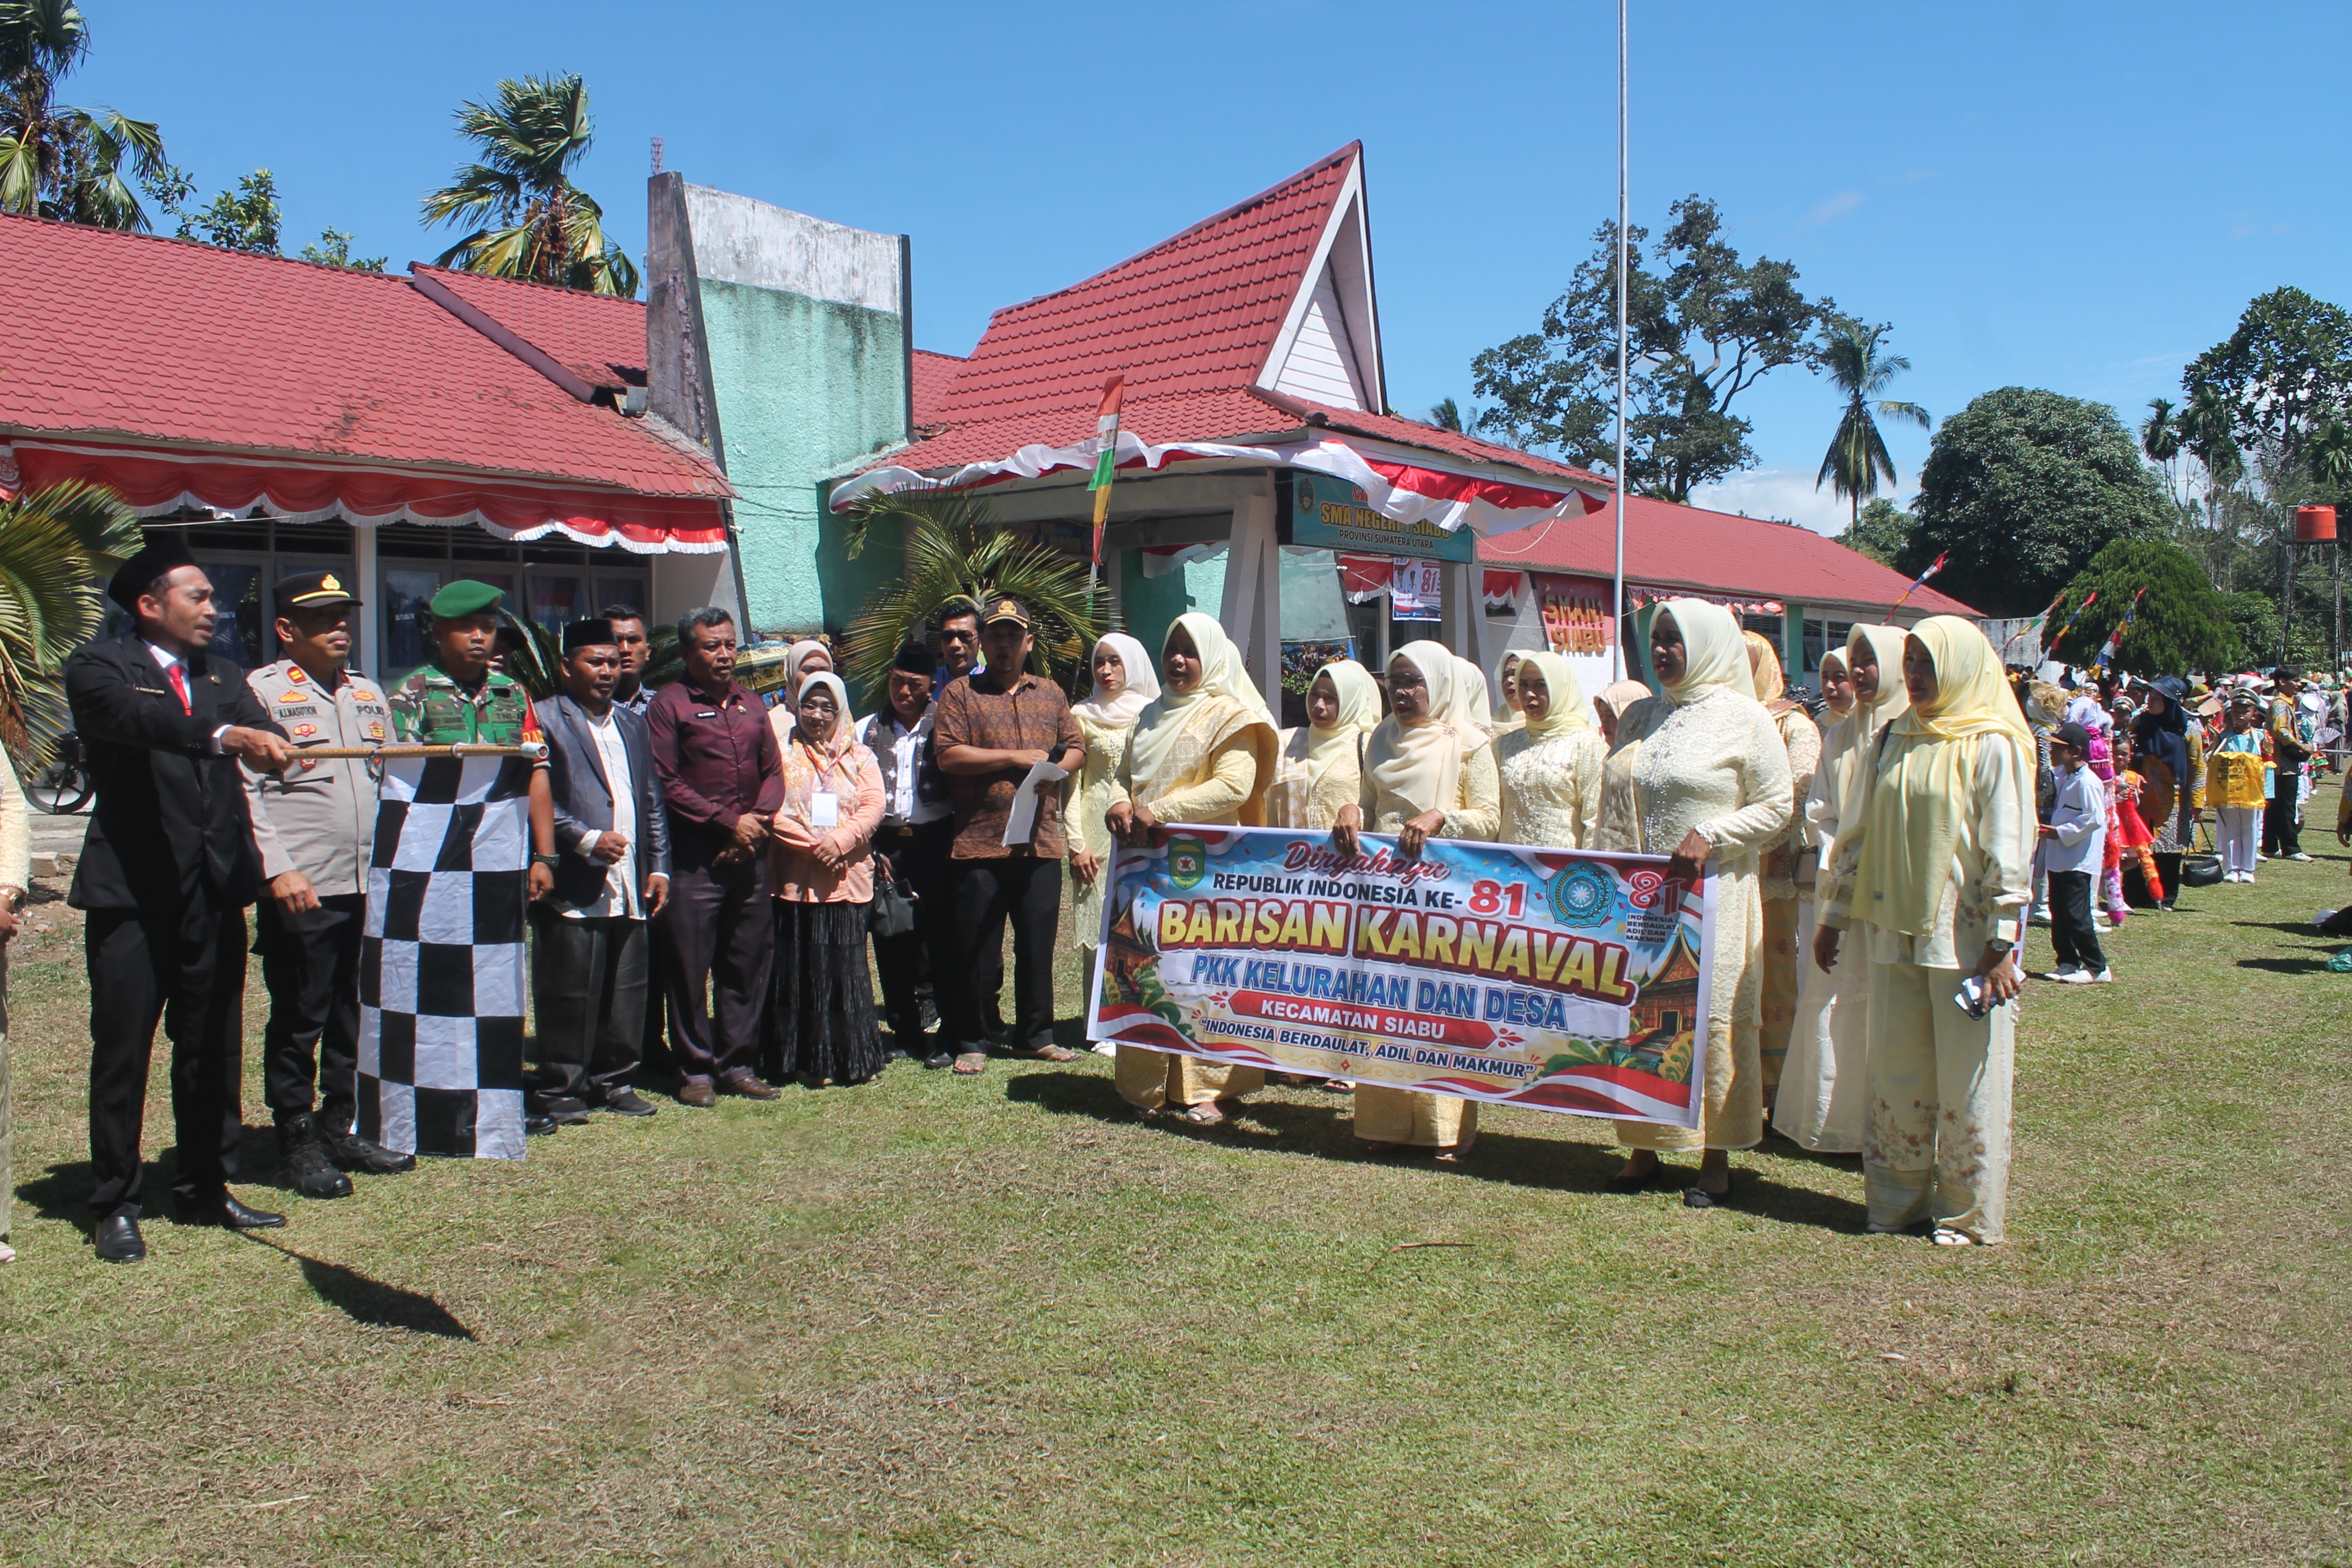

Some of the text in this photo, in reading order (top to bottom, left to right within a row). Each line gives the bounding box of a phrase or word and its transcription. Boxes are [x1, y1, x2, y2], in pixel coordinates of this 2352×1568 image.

[1353, 485, 1369, 502] Sela
[1321, 502, 1353, 527] SMA
[1339, 529, 1434, 549] PROVINSI SUMATERA UTARA
[1551, 627, 1606, 653] SIABU
[356, 705, 385, 716] POLRI
[1284, 841, 1449, 883] Dirgahayu
[1213, 873, 1527, 918] REPUBLIK INDONESIA KE- 81
[1629, 871, 1687, 916] 81
[1627, 914, 1673, 923] INDONESIA
[1627, 921, 1677, 930] BERDAULAT
[1159, 899, 1631, 1001] BARISAN KARNAVAL
[1626, 935, 1666, 943] MAKMUR
[1190, 953, 1568, 1031] PKK KELURAHAN DAN DESA
[1261, 999, 1445, 1039] KECAMATAN SIABU
[1201, 1019, 1535, 1077] “INDONESIA BERDAULAT, ADIL DAN MAKMUR”
